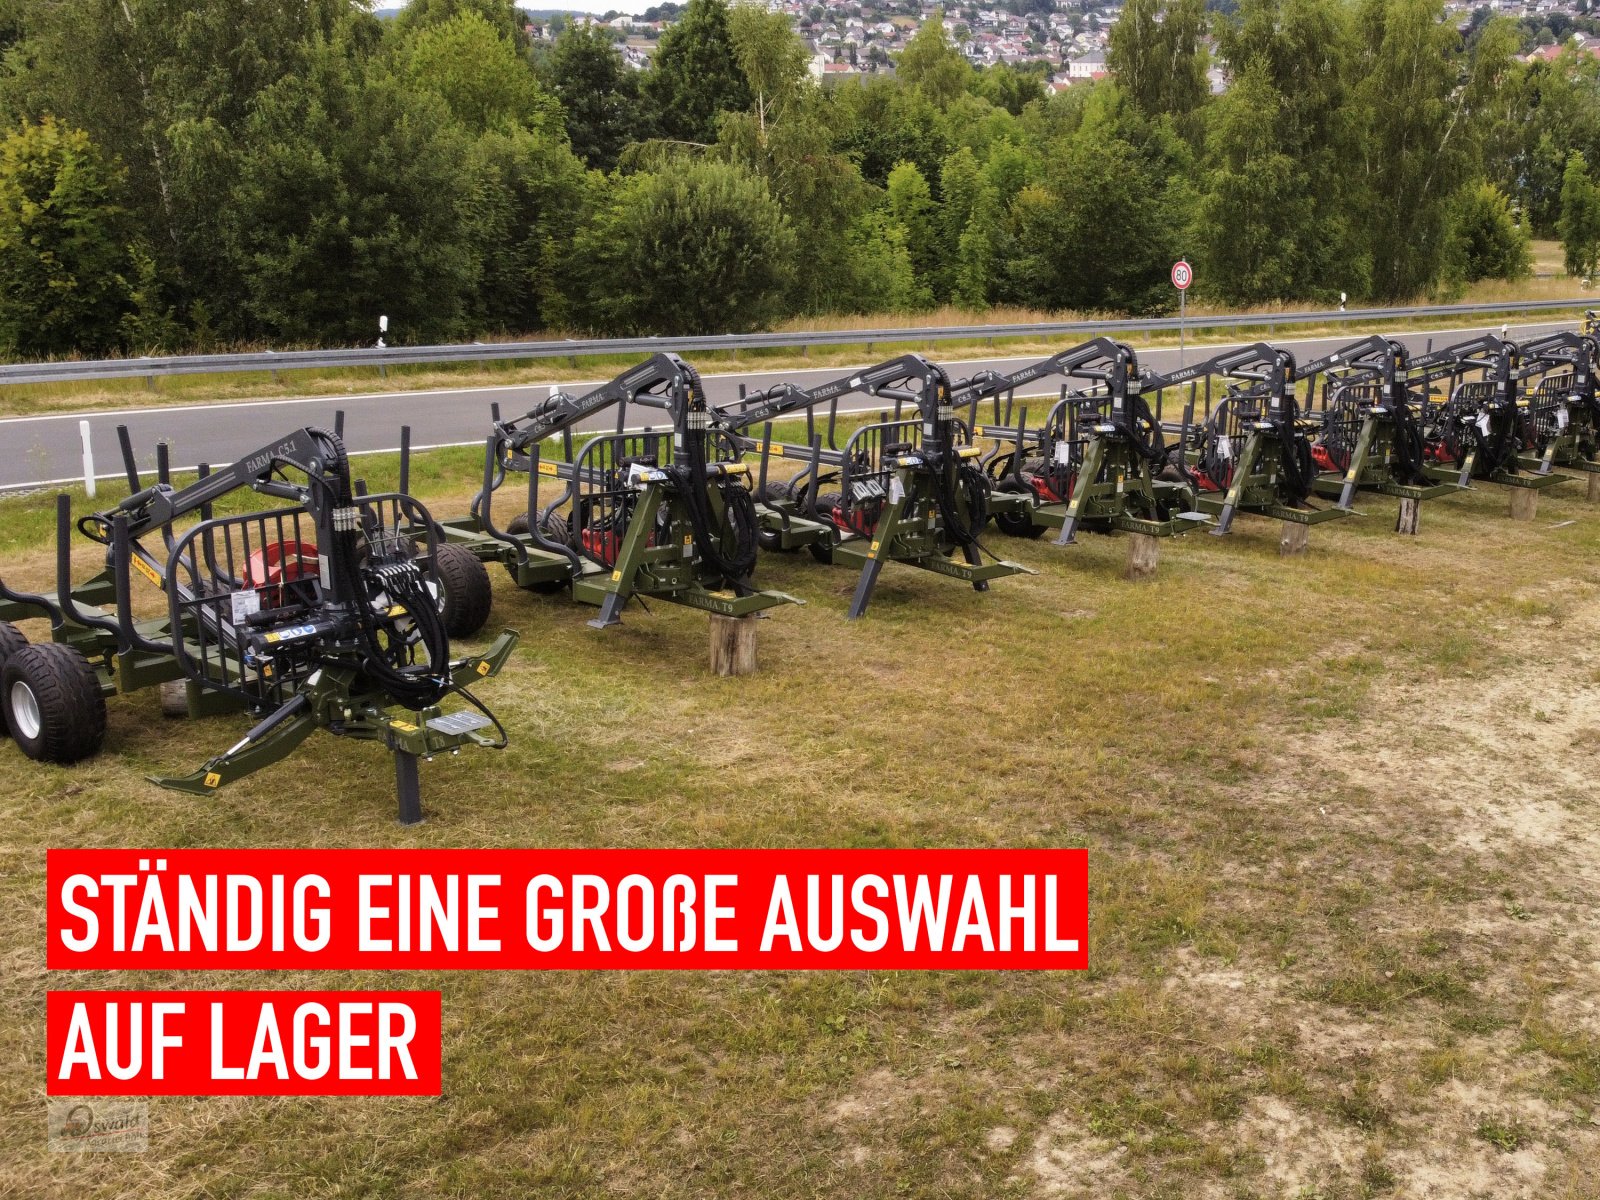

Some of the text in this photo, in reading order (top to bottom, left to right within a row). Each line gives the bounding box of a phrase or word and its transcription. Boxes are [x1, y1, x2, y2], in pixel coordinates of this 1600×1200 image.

[1176, 269, 1188, 281] 80
[1011, 368, 1037, 383] FARMA
[1171, 369, 1197, 381] FARMA
[813, 385, 840, 400] FARMA
[581, 393, 605, 410] FARMA
[245, 440, 297, 473] FARMA C5.1
[1299, 514, 1309, 522] T9
[1121, 520, 1160, 534] FARMA T9
[962, 569, 973, 579] T9
[690, 593, 734, 613] FARMA T9
[432, 735, 446, 749] T8
